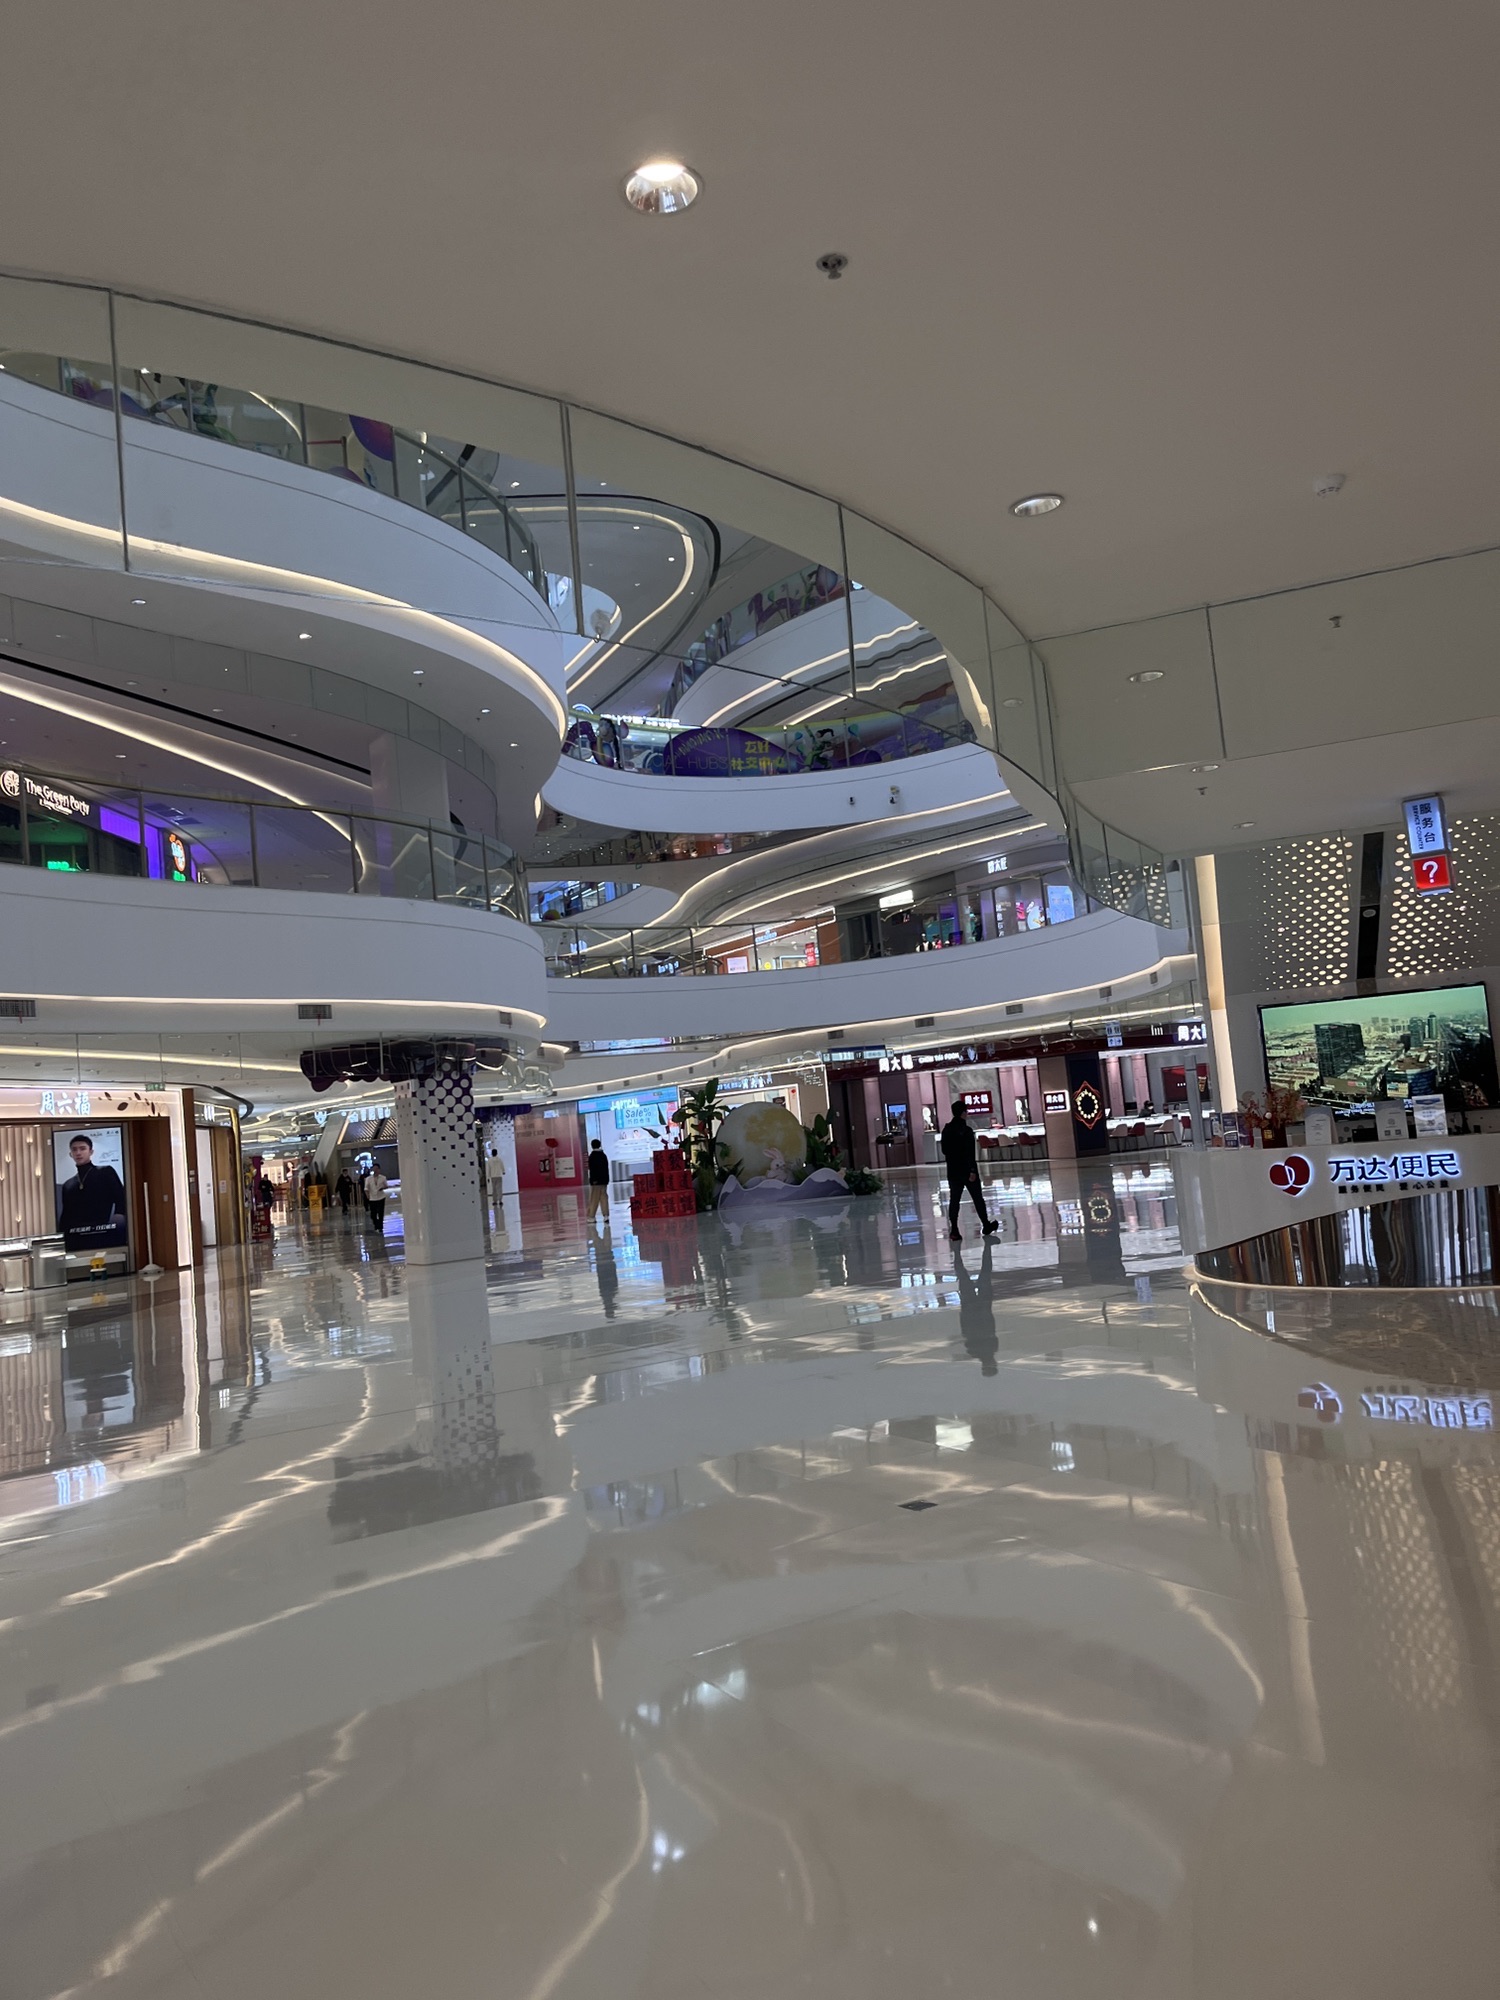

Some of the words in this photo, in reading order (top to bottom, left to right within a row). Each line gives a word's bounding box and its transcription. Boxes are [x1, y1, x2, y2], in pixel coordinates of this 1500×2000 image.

[24, 777, 43, 798] The
[43, 785, 70, 808] Green
[1412, 805, 1420, 826] SERVICE
[1419, 803, 1436, 843] 服务台
[1415, 826, 1424, 850] COUNTER
[39, 1090, 91, 1116] 周六福
[1327, 1153, 1460, 1182] 万达便民
[1338, 1183, 1385, 1194] 服务便民
[1399, 1180, 1450, 1191] 爱心公益
